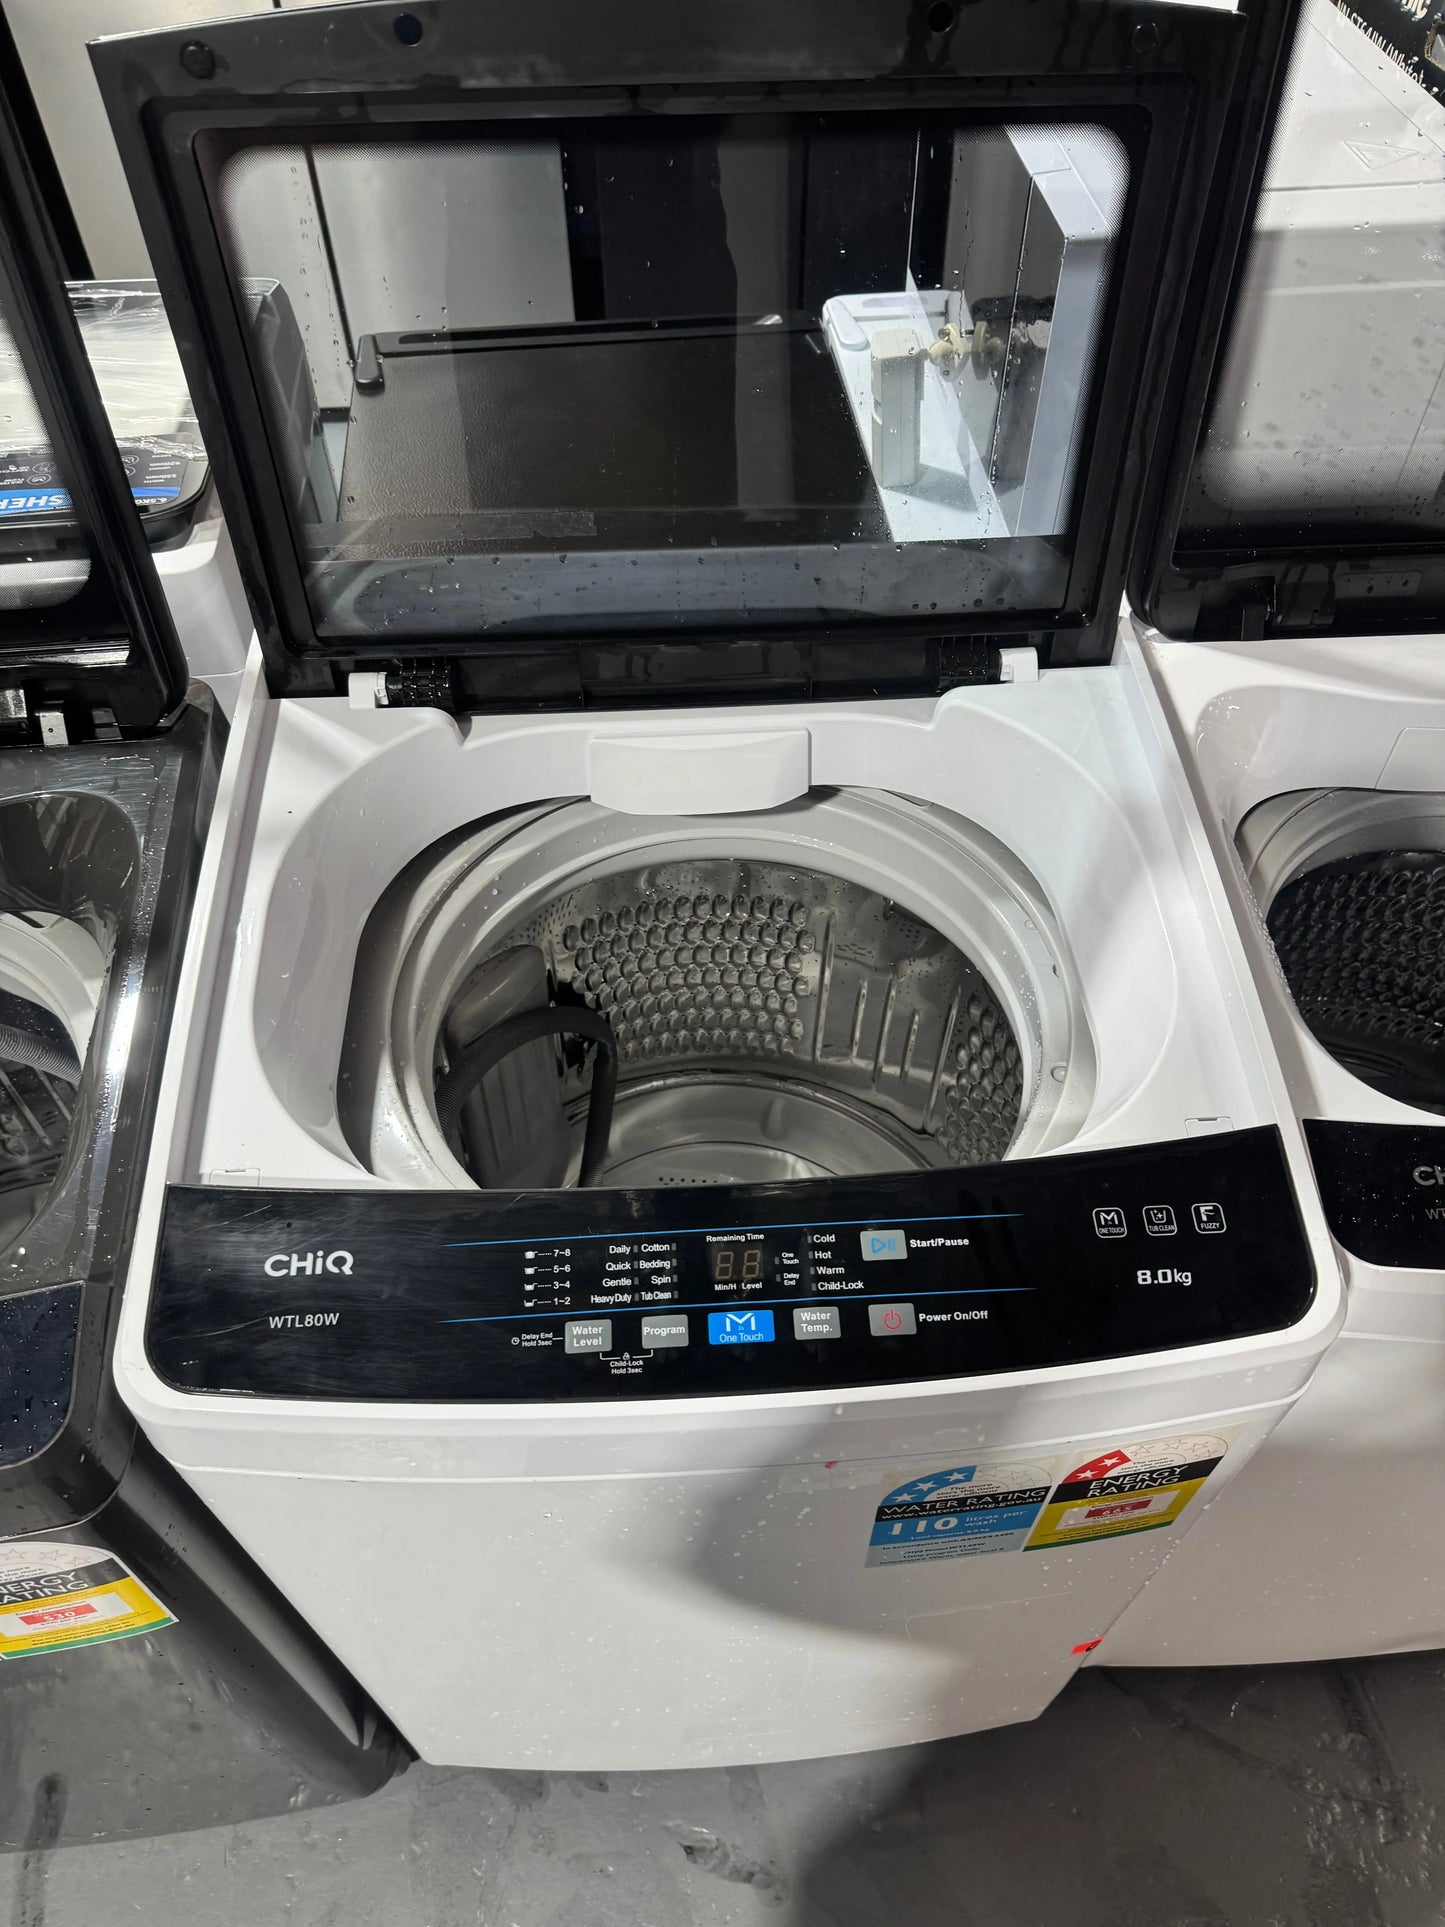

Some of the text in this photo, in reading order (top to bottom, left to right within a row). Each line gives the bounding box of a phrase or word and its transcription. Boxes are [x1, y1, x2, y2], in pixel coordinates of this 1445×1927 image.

[1109, 1226, 1125, 1234] TOUCH
[706, 1234, 746, 1243] Remaining
[813, 1234, 836, 1243] Cold
[910, 1237, 969, 1249] Start/Pause
[609, 1245, 631, 1255] Daily
[641, 1243, 670, 1252] Cotton
[815, 1251, 832, 1260] Hot
[264, 1250, 354, 1277] CHiQ
[605, 1262, 631, 1271] Quick
[640, 1260, 671, 1270] Bedding
[816, 1266, 845, 1275] Warm
[651, 1275, 671, 1285] Spin
[1136, 1268, 1192, 1286] 8.0kg
[602, 1278, 632, 1287] Gentle
[714, 1282, 763, 1291] Min/H Level
[818, 1280, 865, 1291] Child-Lock
[590, 1293, 632, 1305] Heavy Duty
[640, 1291, 672, 1301] Tub Clean
[269, 1312, 340, 1329] WTL80W
[800, 1312, 832, 1322] Water
[919, 1310, 989, 1323] Power On/Off
[572, 1326, 604, 1336] Water
[643, 1325, 686, 1336] Program
[801, 1322, 833, 1334] Temp.
[521, 1333, 540, 1341] Delay
[573, 1337, 602, 1347] Level
[720, 1332, 764, 1343] One Touch
[609, 1360, 644, 1368] Child-Lock
[1090, 1465, 1189, 1489] ENERGY
[1087, 1474, 1180, 1498] RATING
[884, 1489, 1046, 1514] WATER RATING
[882, 1498, 1042, 1519] www.waterrating.gov.au
[892, 1510, 1028, 1535] 110 litres per
[964, 1519, 997, 1527] wash
[0, 1580, 89, 1605] ATING
